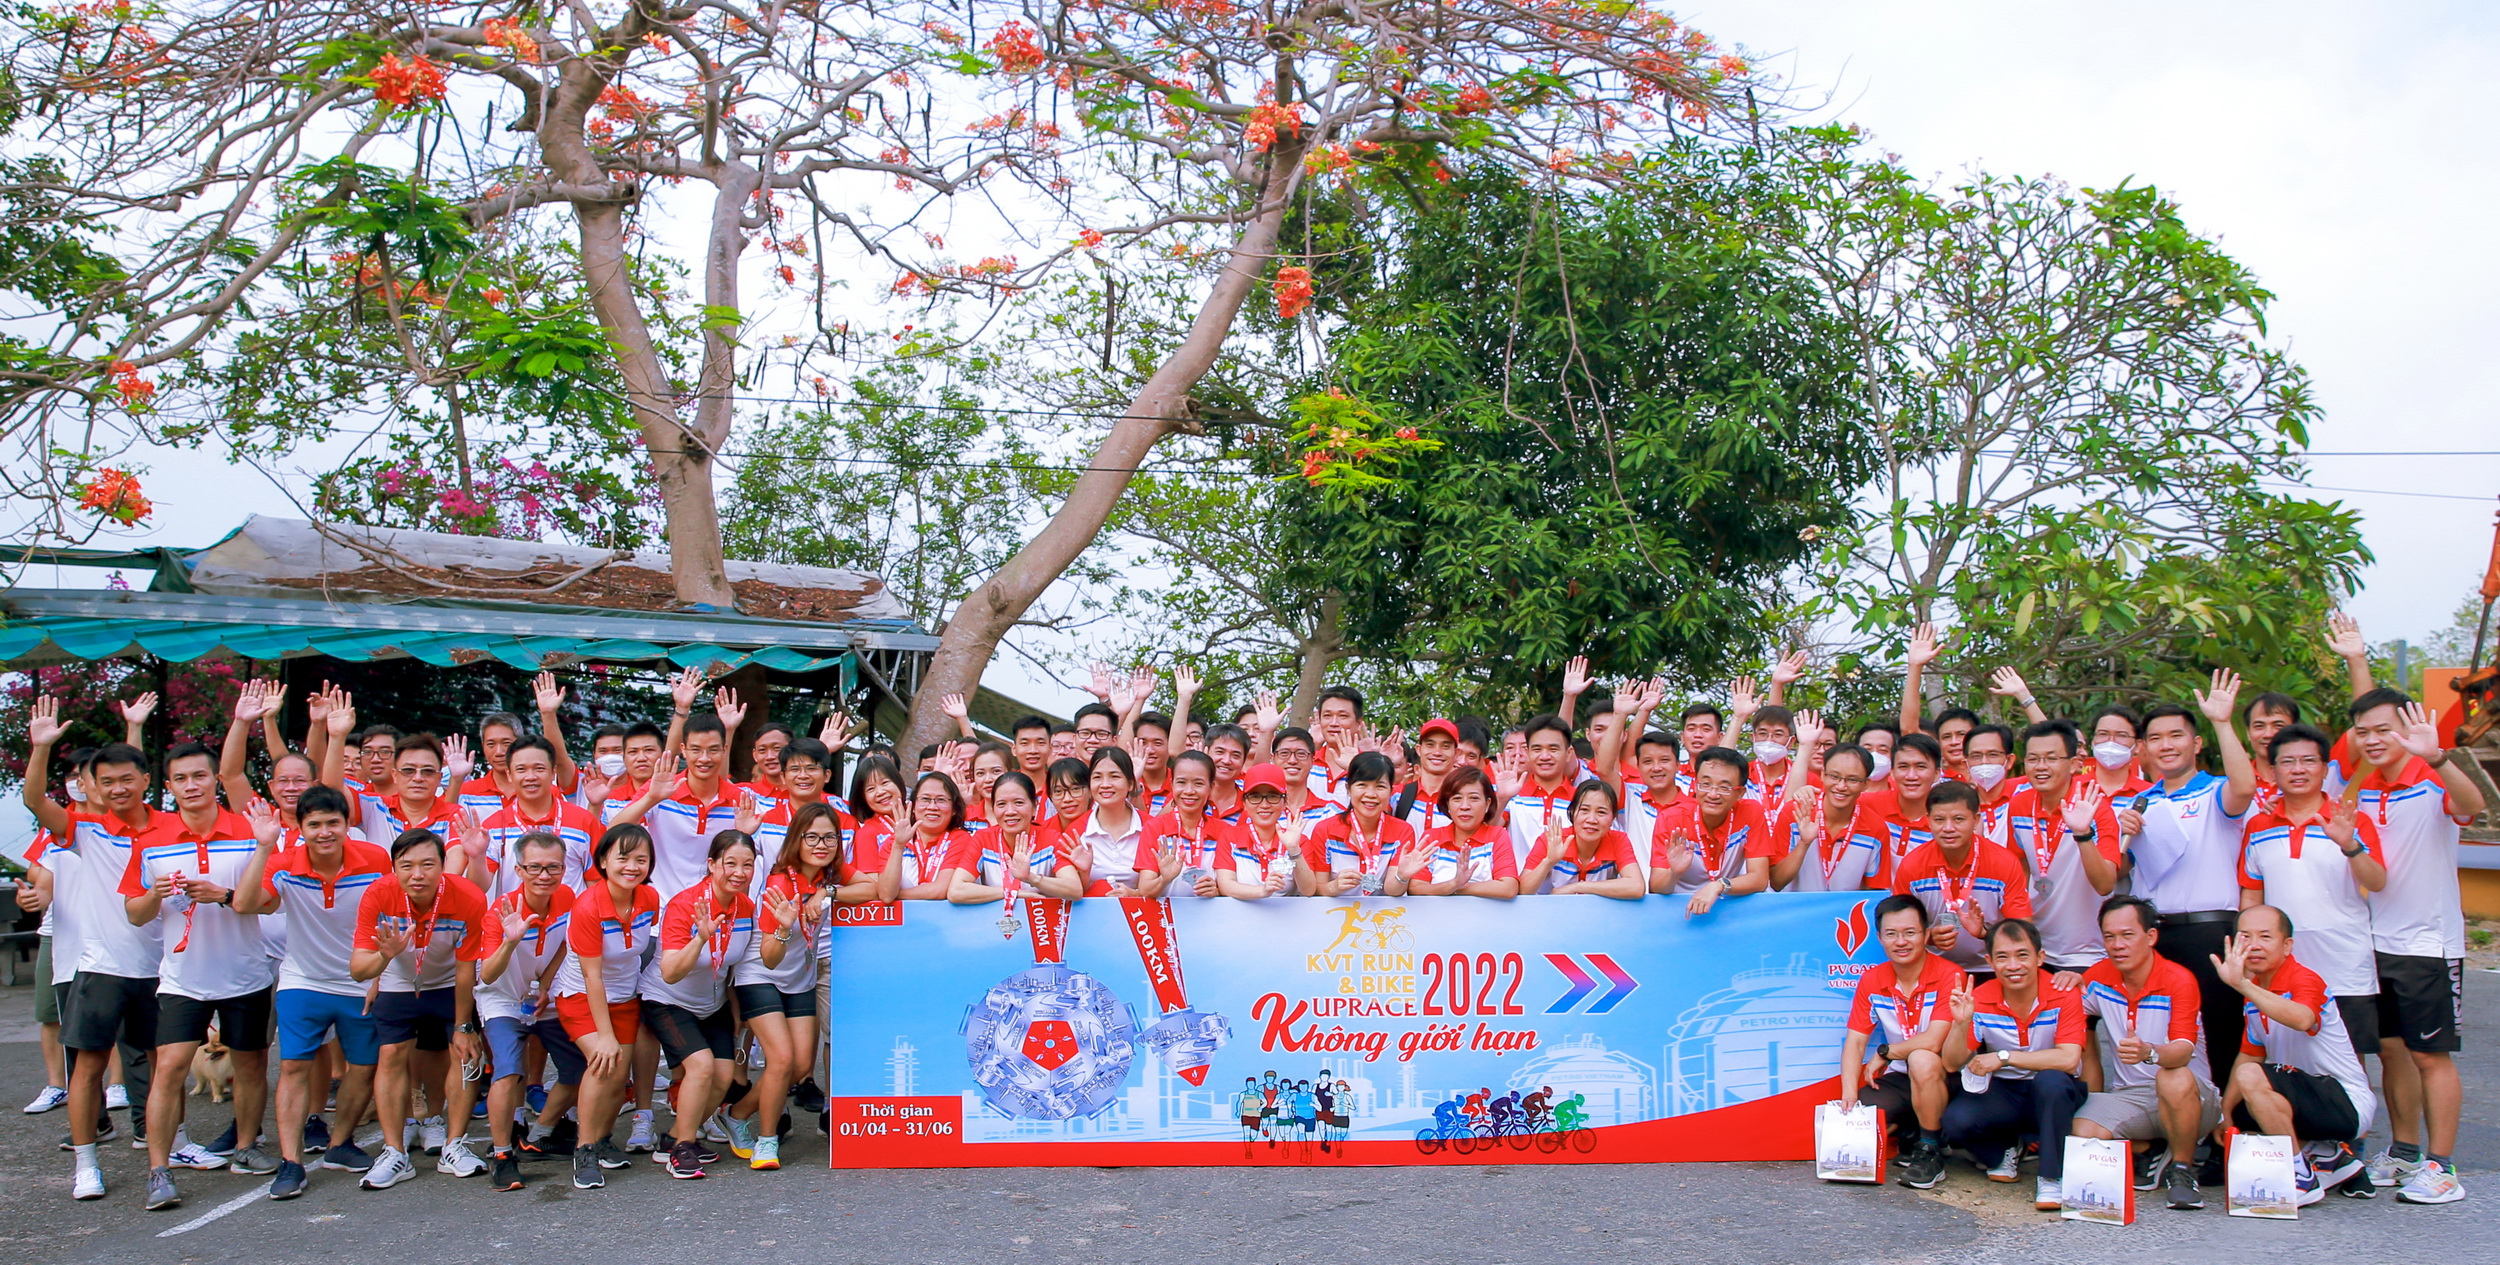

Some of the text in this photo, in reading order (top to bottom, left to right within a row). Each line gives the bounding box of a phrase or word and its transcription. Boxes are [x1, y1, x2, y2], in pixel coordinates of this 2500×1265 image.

[836, 904, 895, 924] QUÝ II
[1031, 899, 1050, 946] 100KM
[1130, 907, 1169, 985] 100KM
[1307, 953, 1414, 972] KVT RUN
[1828, 964, 1847, 975] PV
[1339, 975, 1415, 994] & BIKE
[1422, 952, 1524, 1016] 2022
[1312, 998, 1418, 1017] UPRACE
[1251, 992, 1541, 1063] Không giới hạn
[1740, 1015, 1849, 1027] PETRO VIETNA
[859, 1103, 933, 1119] Thời gian
[840, 1122, 887, 1137] 01/04
[905, 1121, 953, 1137] 31/06
